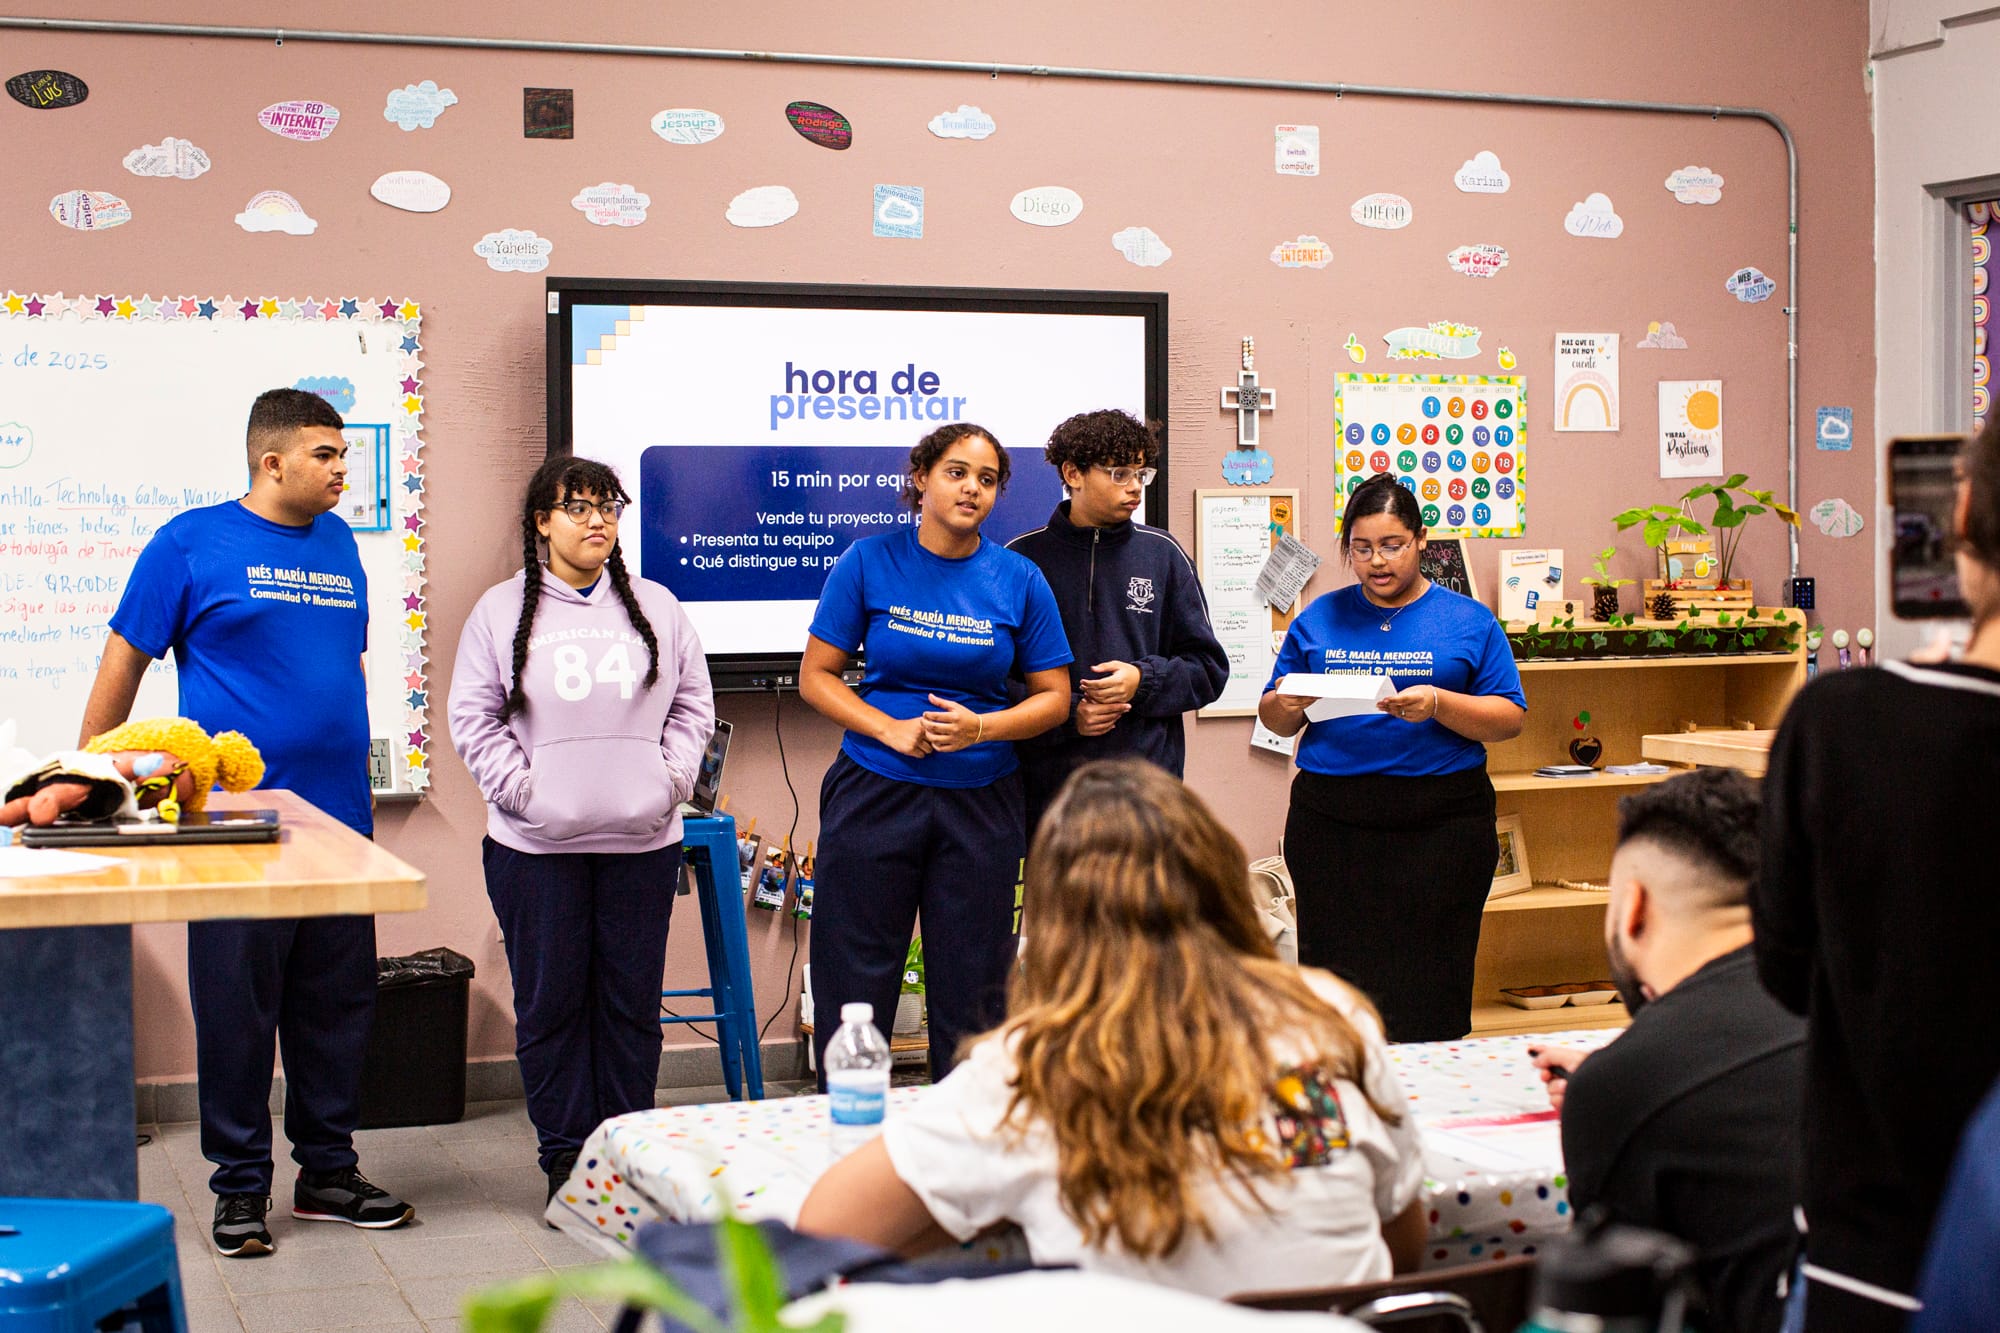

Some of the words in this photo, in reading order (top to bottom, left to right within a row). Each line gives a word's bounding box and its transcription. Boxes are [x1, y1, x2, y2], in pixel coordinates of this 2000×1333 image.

[31, 81, 63, 106] Luis
[305, 103, 323, 114] RED
[270, 112, 326, 130] INTERNET
[660, 119, 716, 130] Jesayra
[797, 116, 843, 130] Rodrigo
[280, 128, 320, 137] COMPUTADORA
[1281, 161, 1314, 172] computer
[1461, 175, 1505, 187] Karina
[587, 195, 639, 207] computadora
[1023, 196, 1071, 215] Diego
[59, 203, 68, 221] red
[82, 193, 94, 228] digital
[1363, 205, 1405, 220] DIEGO
[1575, 214, 1613, 233] Web
[1281, 248, 1324, 262] INTERNET
[1459, 251, 1501, 266] WORD
[1738, 272, 1752, 284] WEB
[1744, 283, 1768, 298] JUSTIN
[14, 343, 39, 367] de
[48, 351, 108, 369] 2025
[785, 361, 877, 395] hora
[891, 363, 940, 395] de
[770, 390, 967, 431] presentar
[1428, 402, 1434, 412] 1
[1453, 402, 1459, 412] 2
[1476, 405, 1483, 415] 3
[1500, 404, 1507, 414] 4
[1352, 429, 1358, 438] 5
[1378, 429, 1384, 438] 6
[1404, 429, 1411, 439] 7
[1427, 429, 1433, 438] 8
[1451, 429, 1458, 439] 9
[1476, 432, 1486, 440] 10
[1498, 431, 1508, 441] 11
[1667, 438, 1710, 459] Positivas
[1350, 457, 1360, 465] 12
[1374, 457, 1386, 466] 13
[1401, 457, 1413, 465] 14
[1427, 457, 1437, 467] 15
[1451, 456, 1462, 466] 16
[1476, 458, 1487, 467] 17
[1499, 458, 1509, 467] 18
[771, 470, 790, 487] 15
[796, 470, 832, 487] min
[838, 473, 870, 492] por
[1425, 485, 1438, 495] 22
[1451, 486, 1464, 495] 23
[1475, 483, 1487, 493] 24
[1499, 483, 1511, 492] 25
[757, 511, 804, 525] Vende
[808, 512, 824, 525] tu
[828, 512, 893, 528] proyecto
[897, 511, 911, 524] al
[1425, 511, 1437, 520] 29
[1450, 511, 1462, 520] 30
[1476, 508, 1488, 519] 31
[692, 533, 758, 547] Presenta
[763, 534, 778, 547] tu
[782, 532, 834, 549] equipo
[78, 545, 95, 560] de
[692, 554, 724, 569] Qué
[728, 554, 798, 571] distingue
[801, 556, 819, 568] su
[247, 563, 272, 580] INÉS
[274, 566, 308, 584] MARÍA
[309, 571, 353, 590] MENDOZA
[250, 587, 300, 604] Comunidad
[312, 594, 357, 609] Montessori
[55, 600, 77, 615] las
[889, 605, 911, 617] INÉS
[913, 609, 944, 624] MARÍA
[946, 613, 993, 631] MENDOZA
[888, 619, 935, 639] Comunidad
[947, 633, 995, 647] Montessori
[1325, 648, 1347, 659] INÉS
[1348, 650, 1381, 660] MARÍA
[1383, 651, 1433, 660] MENDOZA
[553, 643, 637, 702] 84
[1325, 666, 1372, 676] Comunidad
[1385, 667, 1433, 677] Montessori
